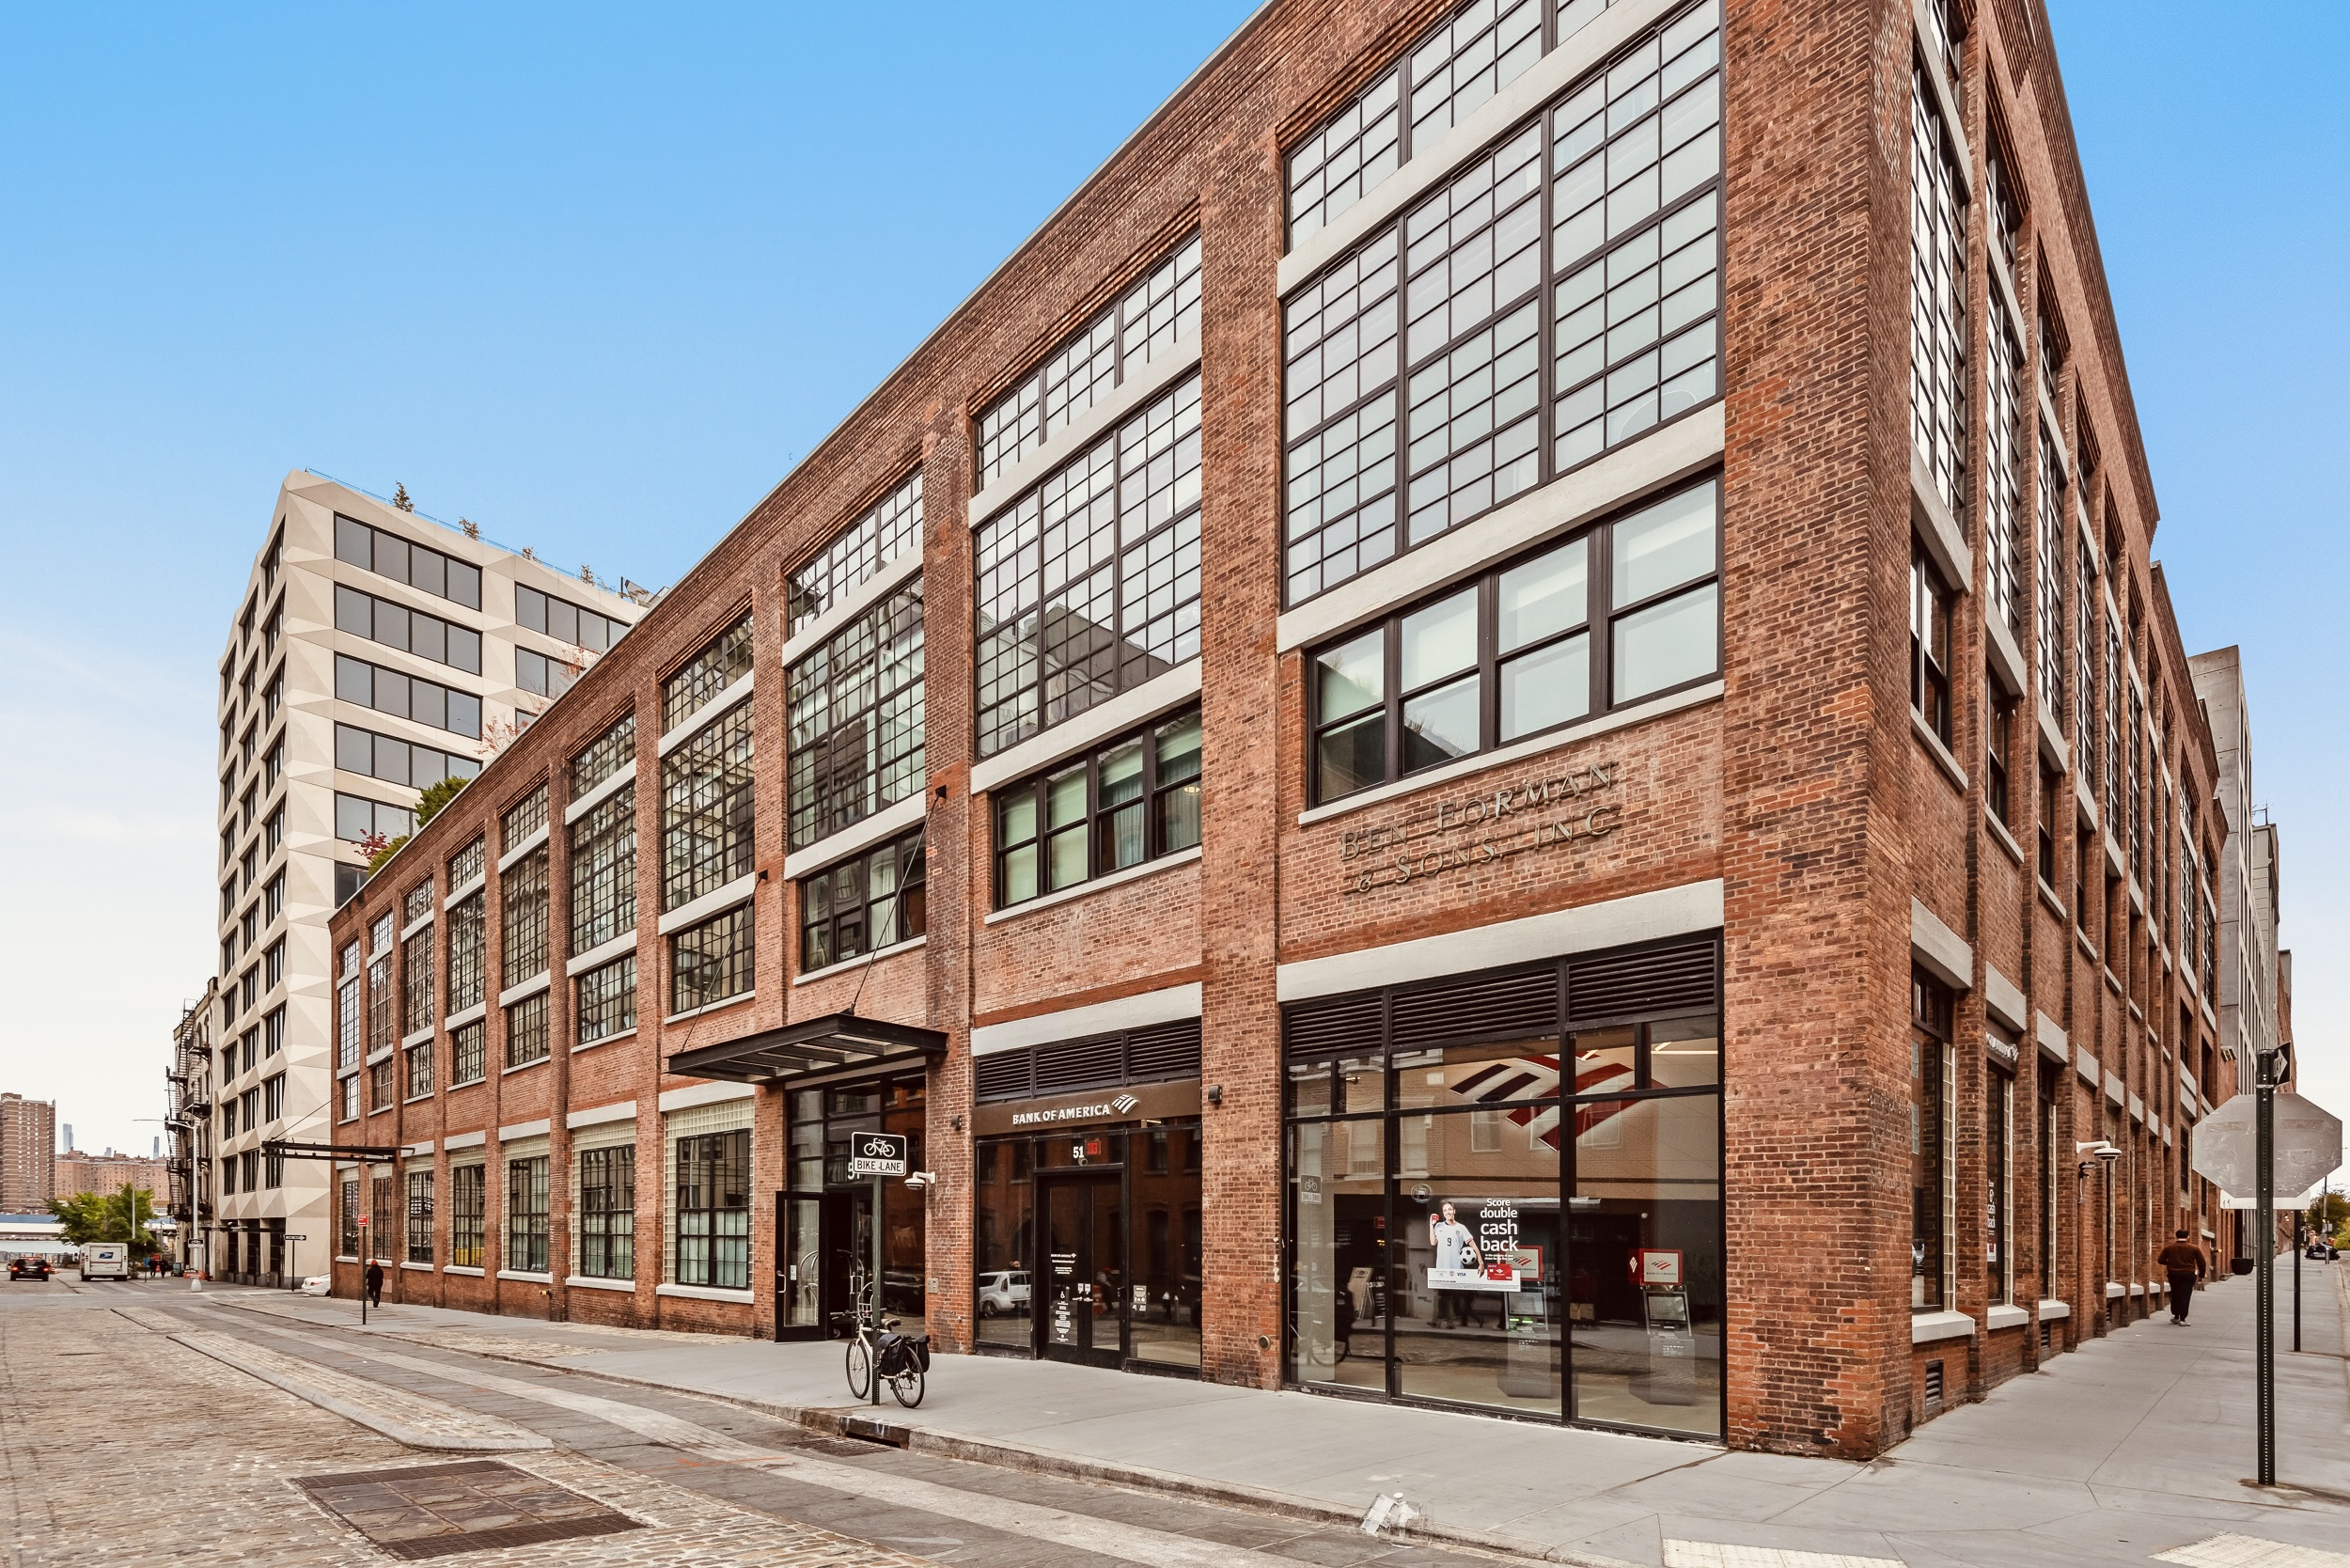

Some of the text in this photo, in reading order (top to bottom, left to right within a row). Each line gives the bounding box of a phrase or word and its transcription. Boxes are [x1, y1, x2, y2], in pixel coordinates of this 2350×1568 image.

[1340, 759, 1616, 861] BEN FORMAN
[1357, 869, 1373, 893] &
[1012, 1104, 1112, 1125] BANK OF AMERICA
[1073, 1145, 1085, 1159] 51
[856, 1159, 901, 1172] BIKE LANE
[1486, 1198, 1511, 1207] Score
[1480, 1207, 1518, 1218] double
[1480, 1219, 1518, 1235] cash
[1447, 1237, 1452, 1247] 9
[1480, 1235, 1519, 1252] back
